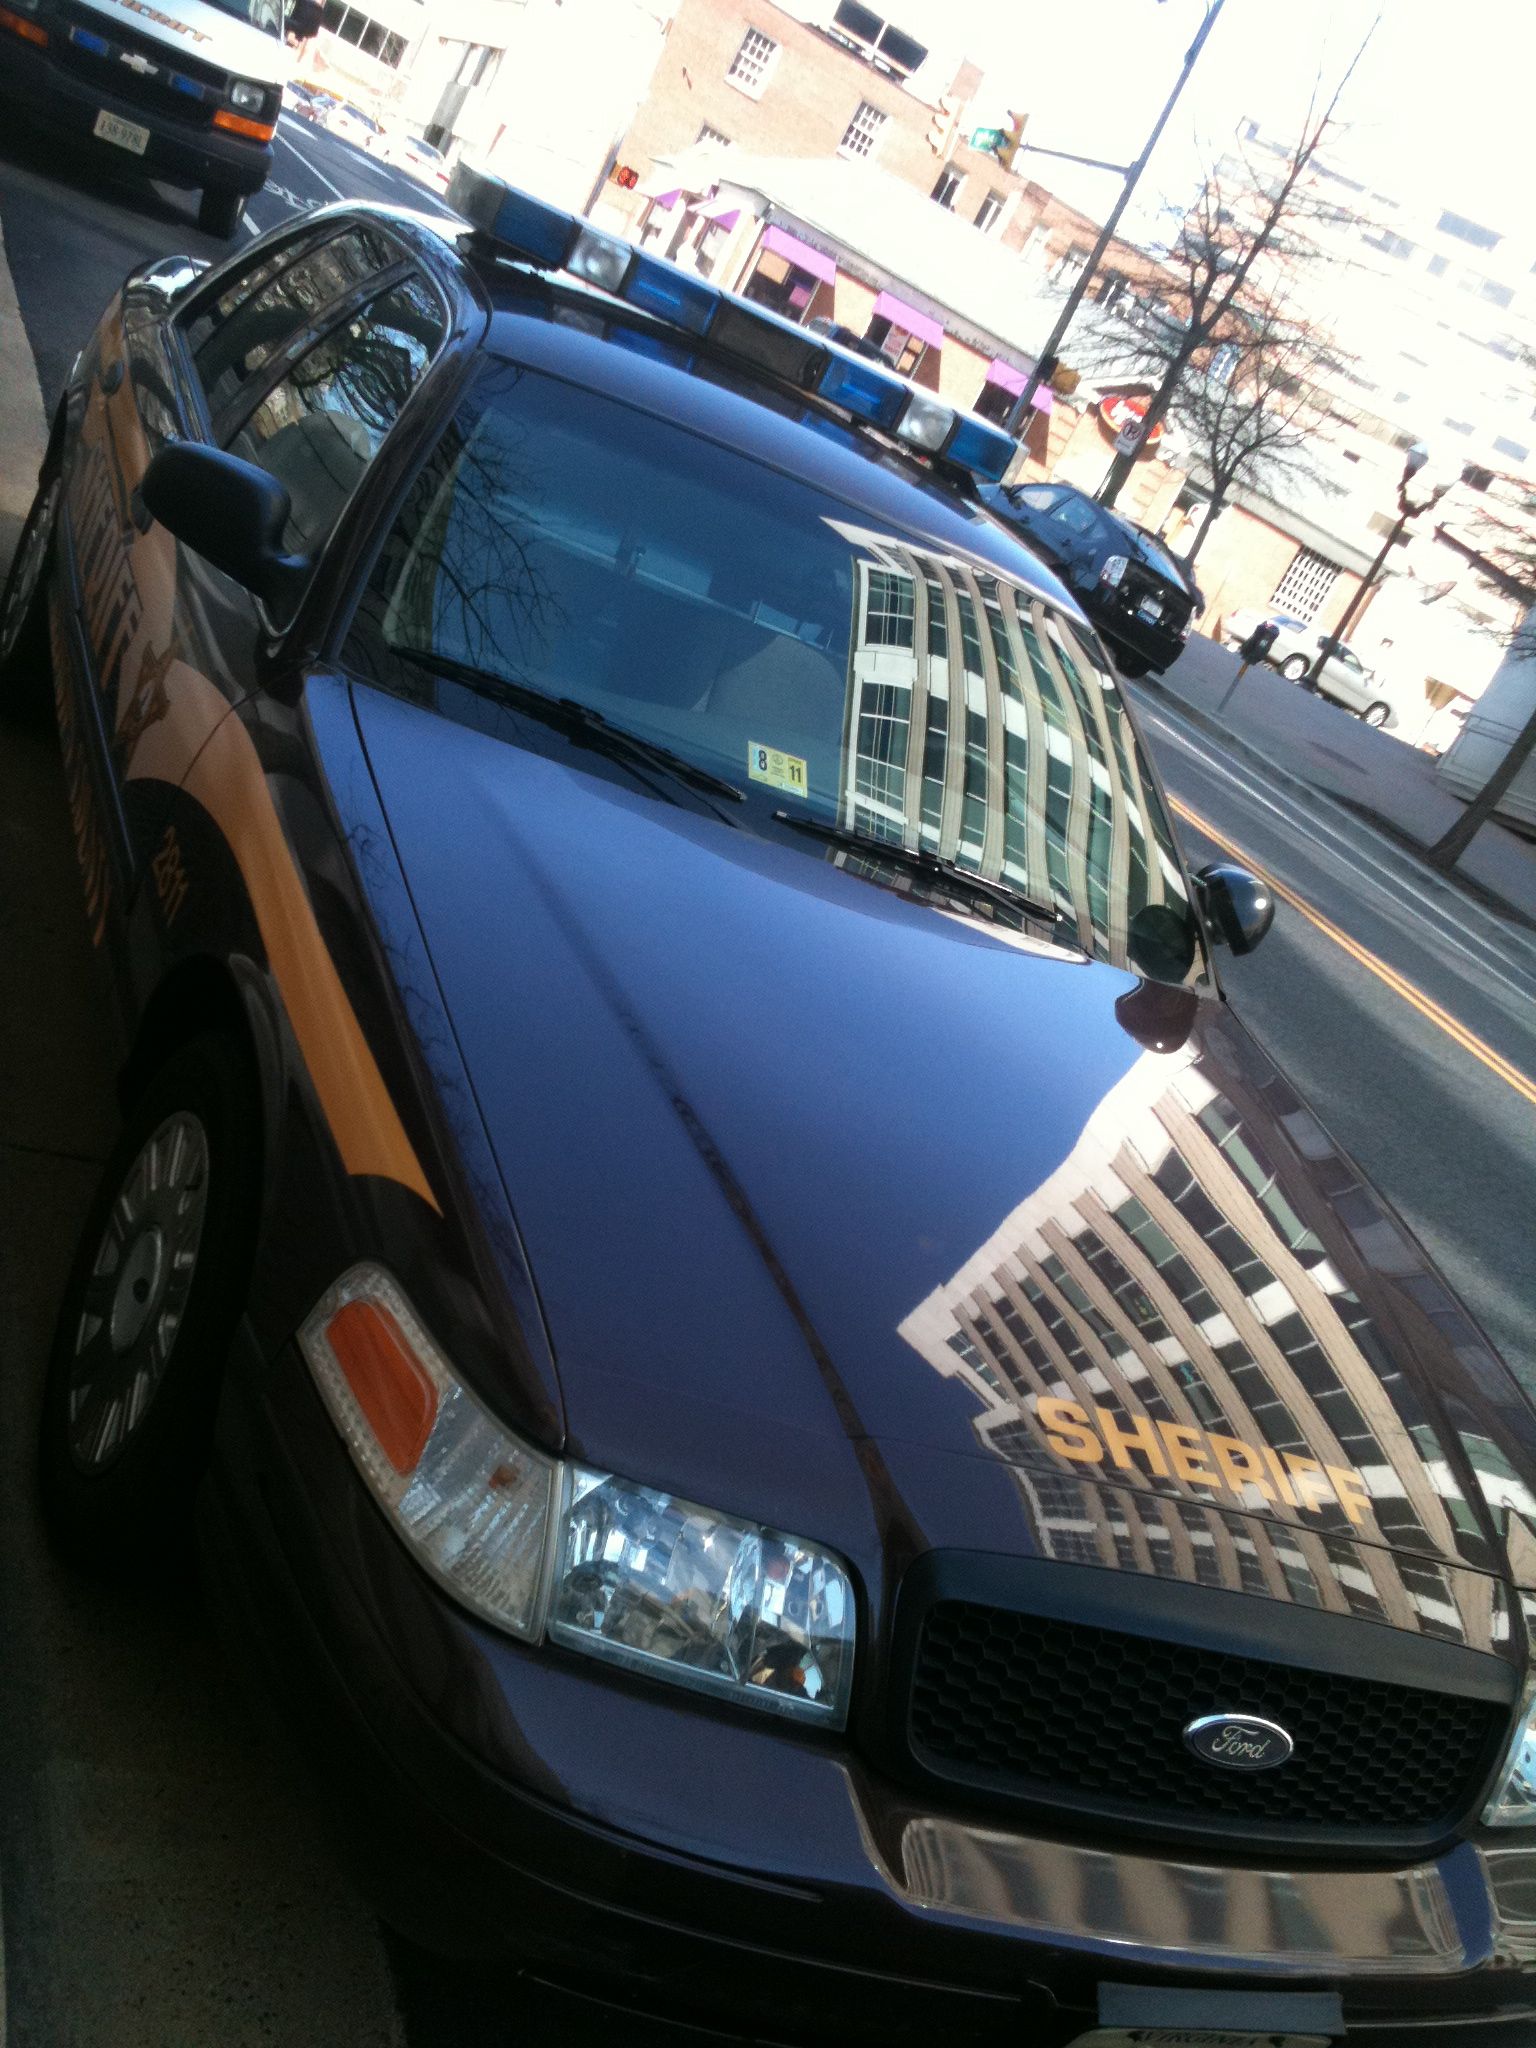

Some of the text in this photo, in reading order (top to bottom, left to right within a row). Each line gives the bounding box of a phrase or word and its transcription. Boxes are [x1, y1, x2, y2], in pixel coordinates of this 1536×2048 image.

[758, 749, 802, 783] 8 11
[1036, 1395, 1374, 1526] SHERIFF
[1211, 1725, 1272, 1759] Ford
